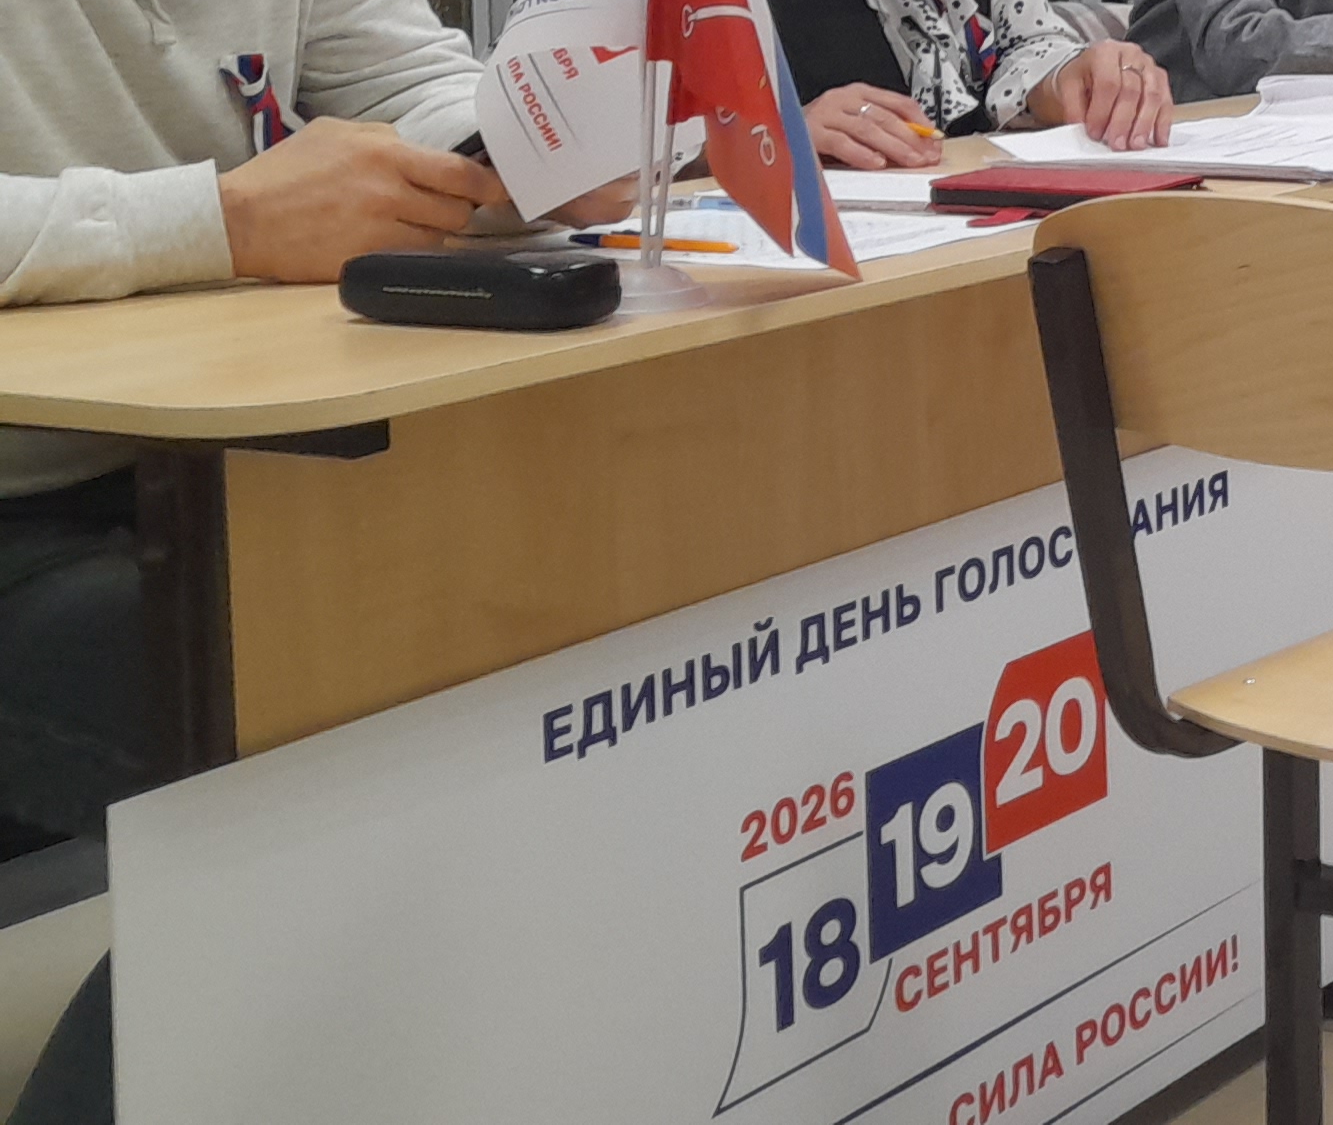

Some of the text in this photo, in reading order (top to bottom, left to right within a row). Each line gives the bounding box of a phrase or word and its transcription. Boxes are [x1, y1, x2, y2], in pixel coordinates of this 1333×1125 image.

[518, 82, 563, 152] РОССИИ!
[542, 470, 1230, 764] ЕДИНЫЙ ДЕНЬ ГОЛОСАНИЯ
[741, 771, 856, 862] 2026
[758, 676, 1097, 1032] 18 19 20
[894, 861, 1112, 1013] СЕНТЯБРЯ
[948, 934, 1240, 1125] СИЛА РОССИИ!
